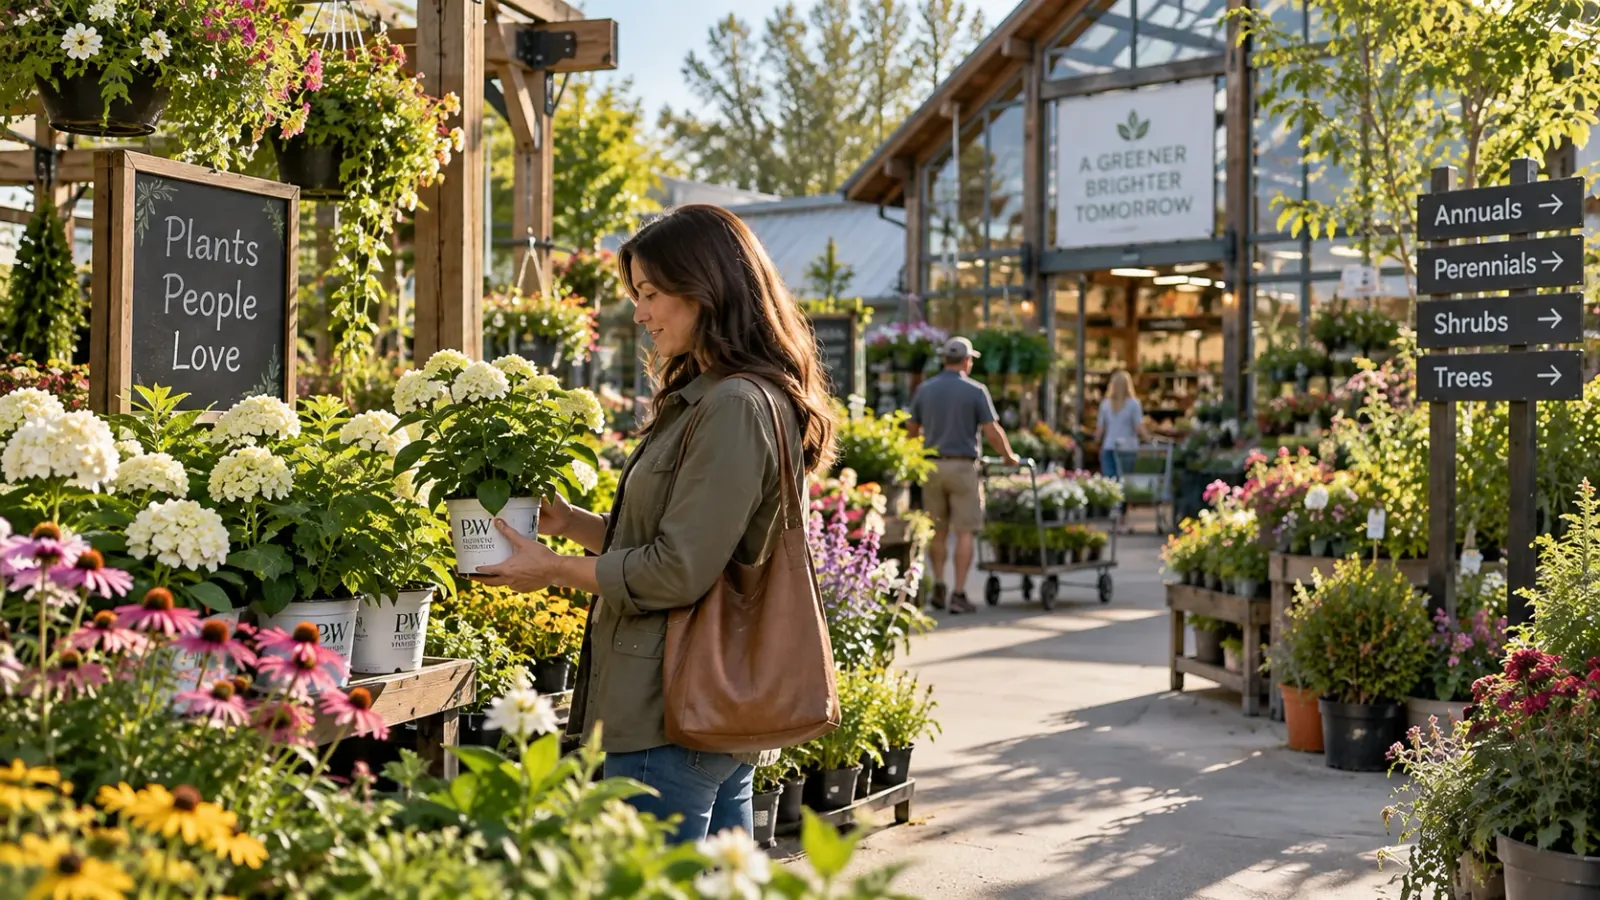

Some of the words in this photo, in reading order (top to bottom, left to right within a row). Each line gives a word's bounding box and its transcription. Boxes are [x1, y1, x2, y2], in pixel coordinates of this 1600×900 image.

[1079, 156, 1092, 174] A
[1097, 144, 1188, 172] GREENER
[1085, 171, 1183, 198] BRIGHTER
[1074, 195, 1194, 223] TOMORROW
[1434, 197, 1522, 227] Annuals
[164, 215, 259, 267] Plants
[1434, 251, 1537, 280] Perennials
[162, 273, 258, 332] People
[1434, 310, 1509, 335] Shrubs
[172, 330, 241, 372] Love
[1433, 366, 1493, 388] Trees
[461, 518, 492, 538] PW
[316, 621, 350, 644] PW
[394, 610, 426, 633] PW
